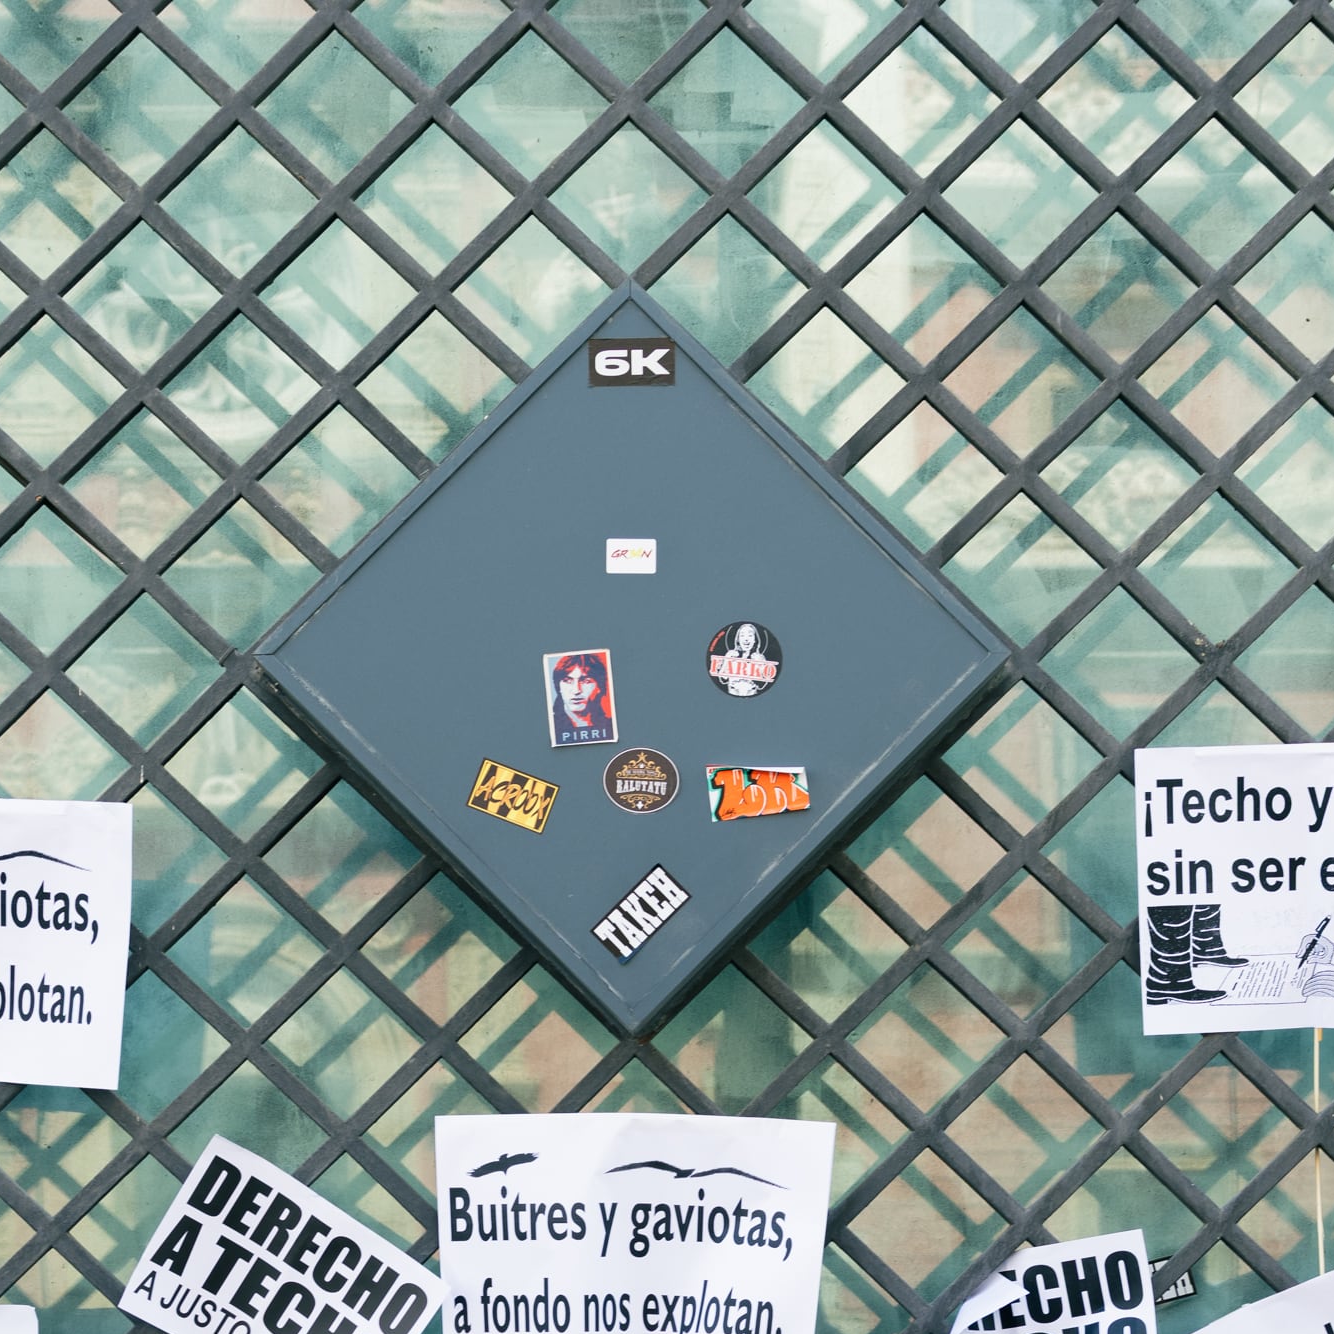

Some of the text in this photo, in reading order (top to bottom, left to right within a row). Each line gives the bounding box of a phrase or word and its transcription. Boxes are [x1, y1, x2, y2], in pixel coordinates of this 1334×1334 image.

[594, 349, 669, 377] 6K
[562, 729, 607, 742] PIRRI
[1144, 777, 1292, 837] ¡Techo
[1308, 786, 1333, 832] y
[1146, 849, 1213, 895] sin
[1231, 855, 1306, 893] ser
[593, 866, 690, 958] TAKER
[448, 1186, 793, 1261] Buitres y gaviotas,
[453, 1295, 471, 1334] a
[482, 1278, 570, 1334] fondo
[583, 1292, 629, 1334] nos
